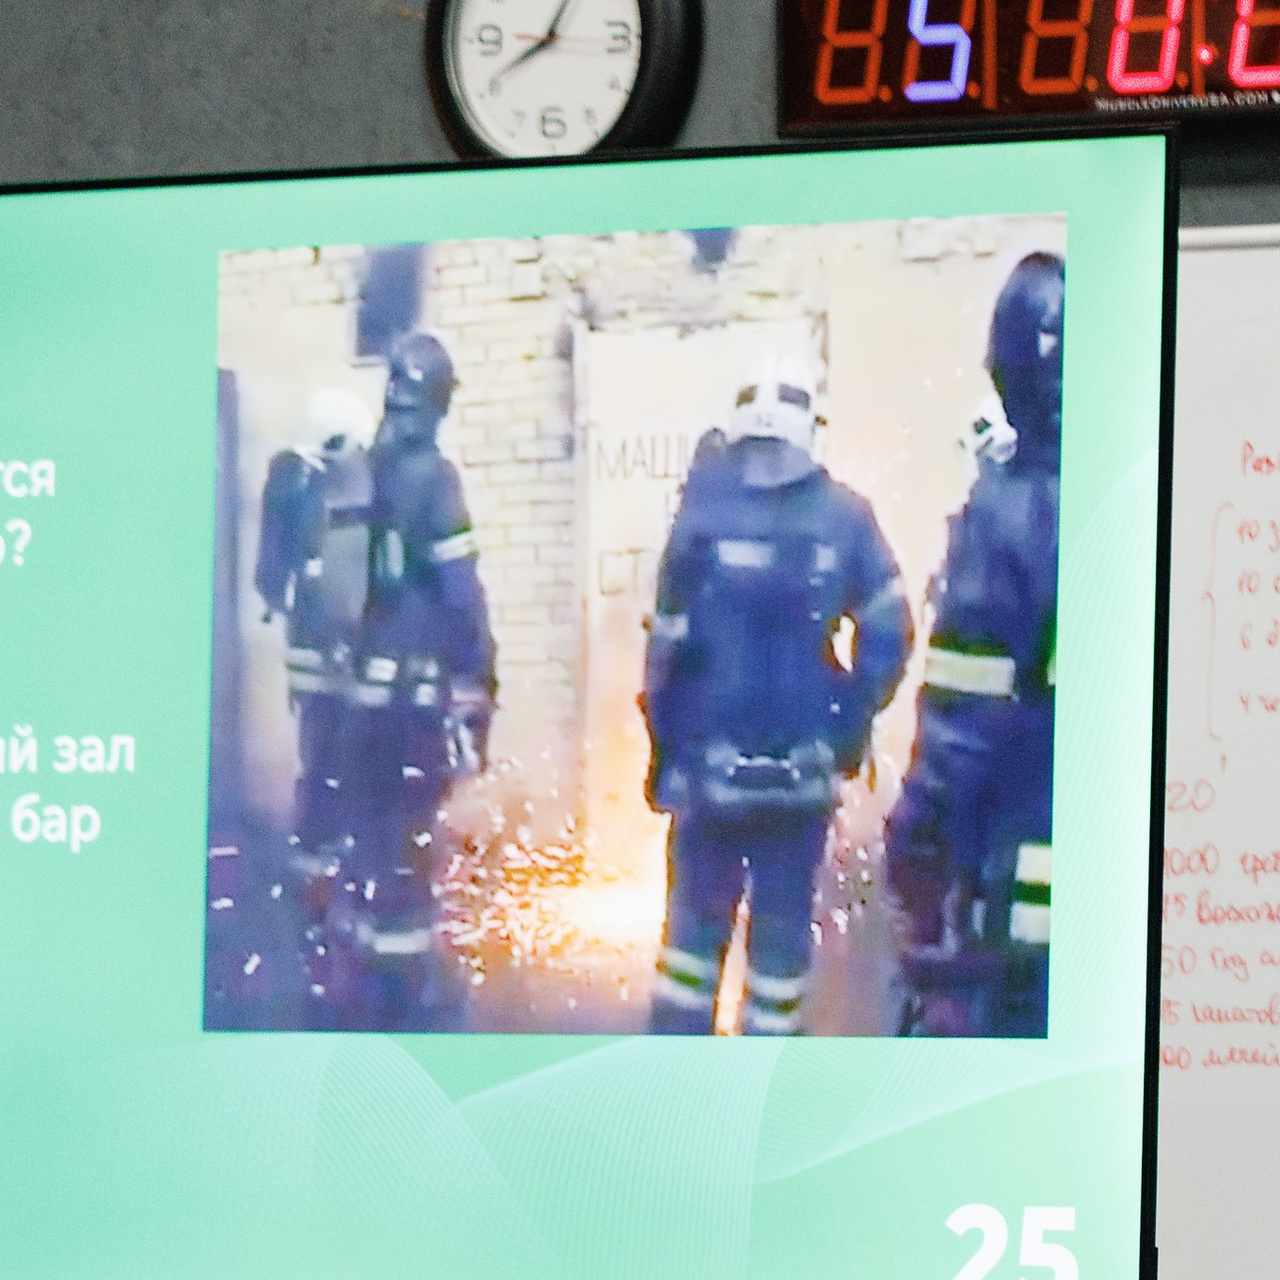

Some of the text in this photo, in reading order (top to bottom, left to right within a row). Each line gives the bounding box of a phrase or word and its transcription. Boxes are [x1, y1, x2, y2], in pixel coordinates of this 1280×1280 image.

[478, 23, 502, 56] 9
[606, 20, 631, 54] 3
[541, 105, 567, 139] 6
[0, 459, 57, 497] ся
[53, 734, 137, 773] зал
[10, 791, 102, 854] бар
